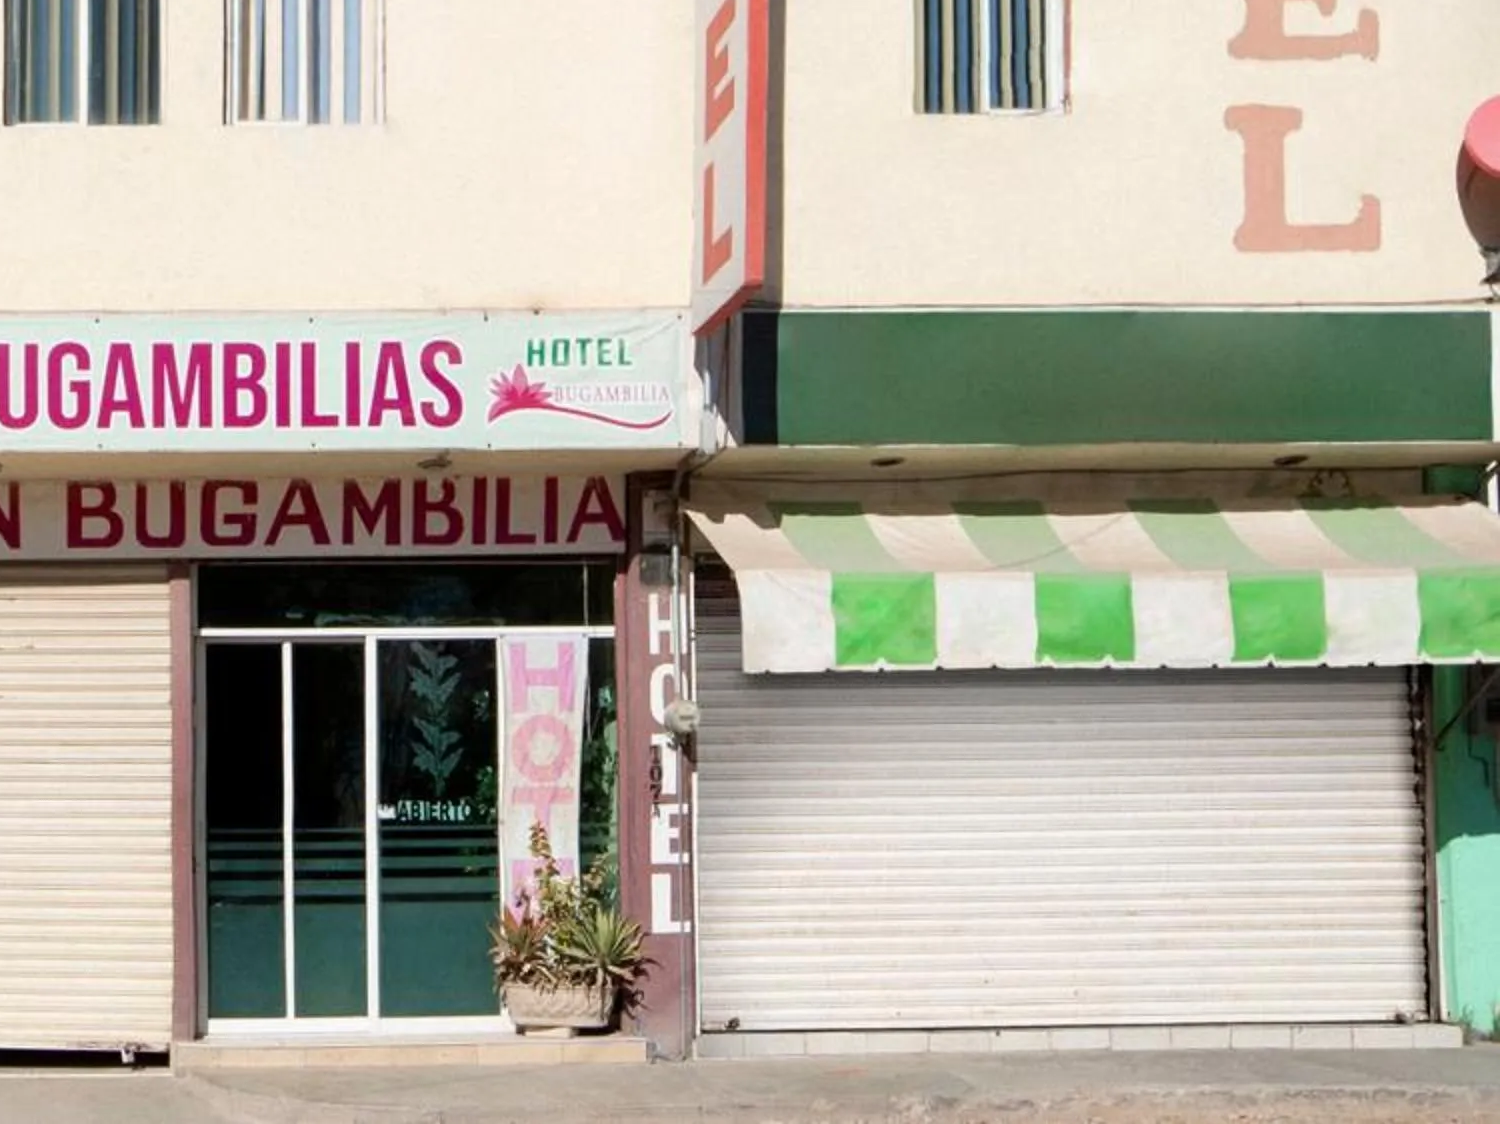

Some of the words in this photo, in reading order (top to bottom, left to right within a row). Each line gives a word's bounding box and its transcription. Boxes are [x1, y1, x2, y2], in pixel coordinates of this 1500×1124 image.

[526, 338, 633, 367] HOTEL
[553, 384, 670, 403] BUGAMBILIA
[65, 476, 626, 550] BUGAMBILIA
[509, 641, 575, 926] HOT
[649, 593, 691, 934] HOTEL
[397, 798, 473, 822] ABIERTO
